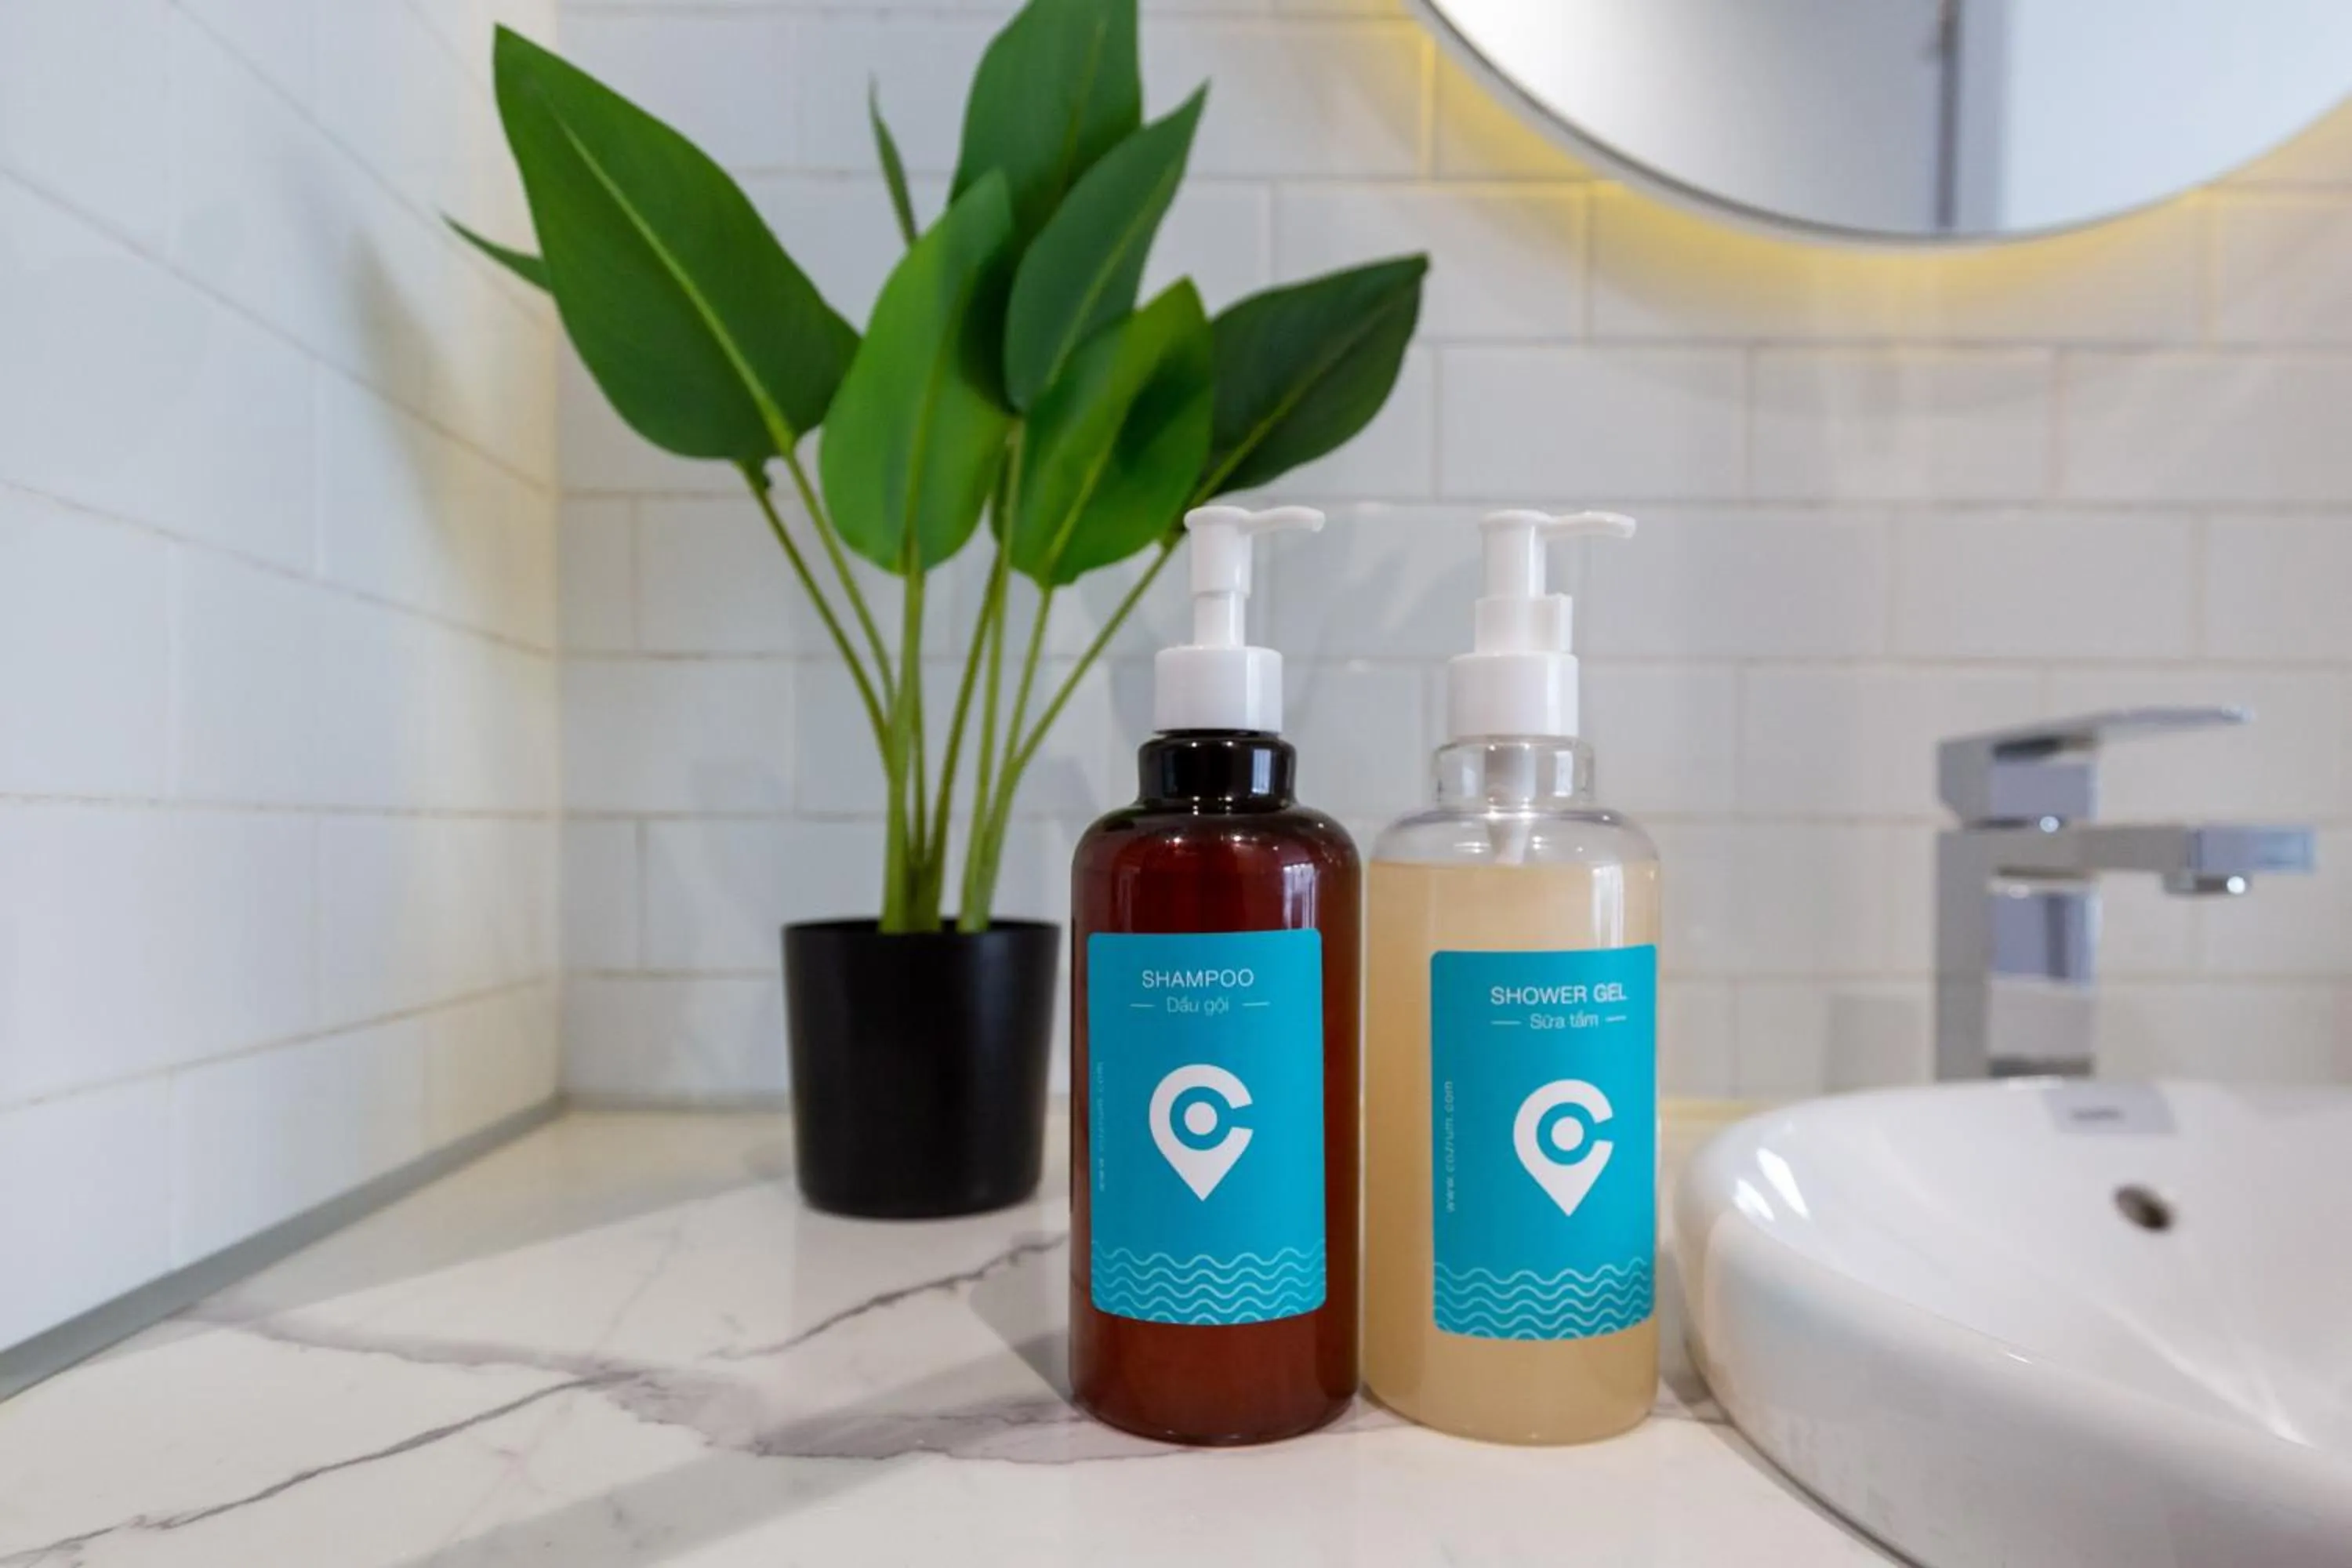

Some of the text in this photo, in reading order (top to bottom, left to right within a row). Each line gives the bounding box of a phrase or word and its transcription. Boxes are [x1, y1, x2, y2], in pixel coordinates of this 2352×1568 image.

[1142, 967, 1254, 989] SHAMPOO
[1490, 982, 1629, 1006] SHOWER GEL
